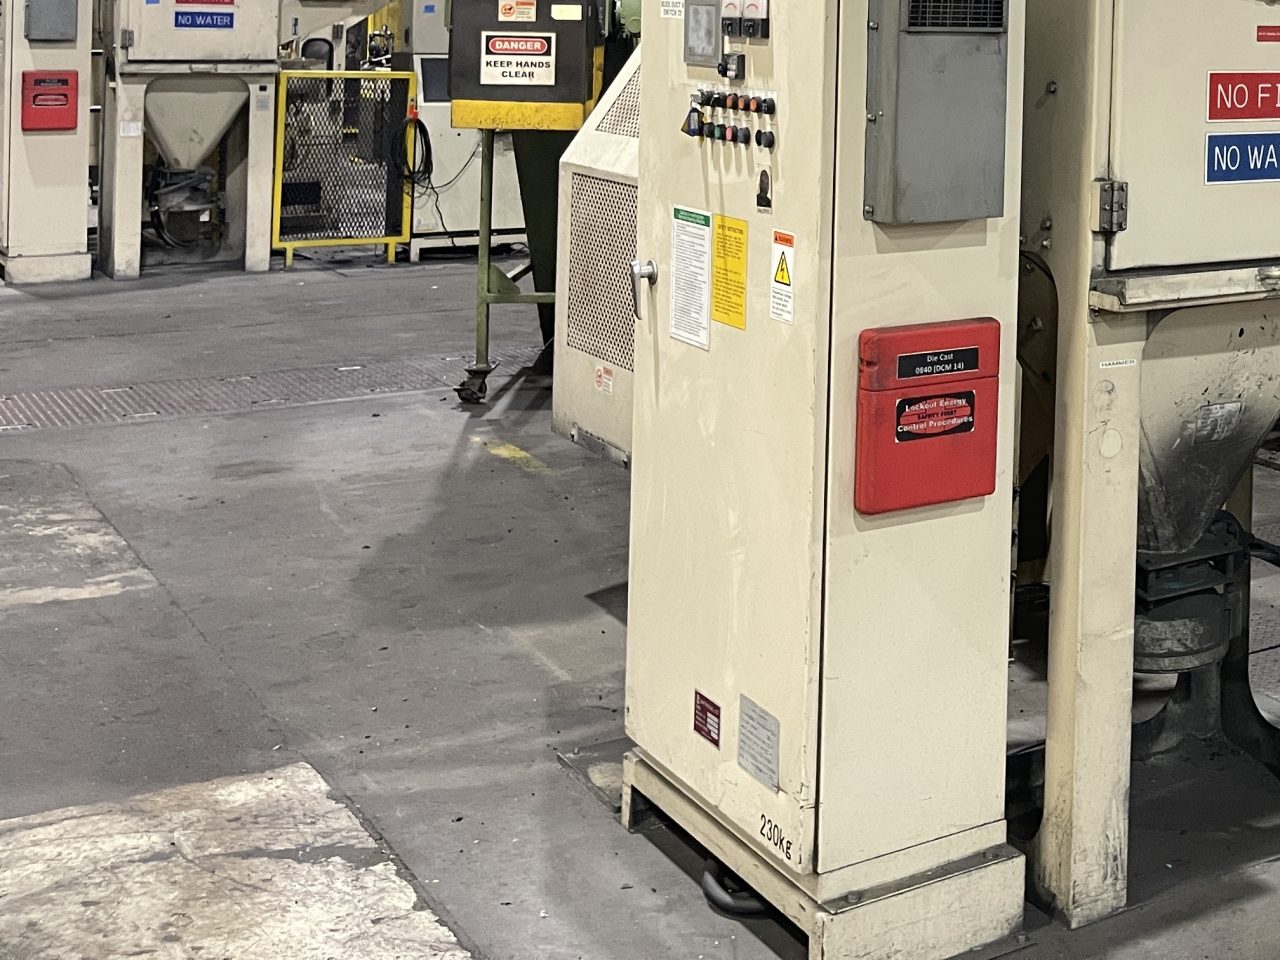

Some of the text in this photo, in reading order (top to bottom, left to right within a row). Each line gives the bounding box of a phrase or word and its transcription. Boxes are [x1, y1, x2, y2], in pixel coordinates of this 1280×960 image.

[178, 15, 231, 26] NO WATER
[495, 41, 541, 50] DANGER
[486, 60, 551, 69] KEEP HANDS
[501, 70, 535, 79] CLEAR
[1217, 83, 1249, 109] NO
[1214, 146, 1241, 171] NO
[939, 353, 954, 361] Cast
[933, 363, 952, 374] (DCM
[953, 361, 964, 371] 14)
[905, 398, 967, 412] Lockout Energy
[897, 415, 973, 432] Control Procedures
[759, 813, 793, 861] 230kg
